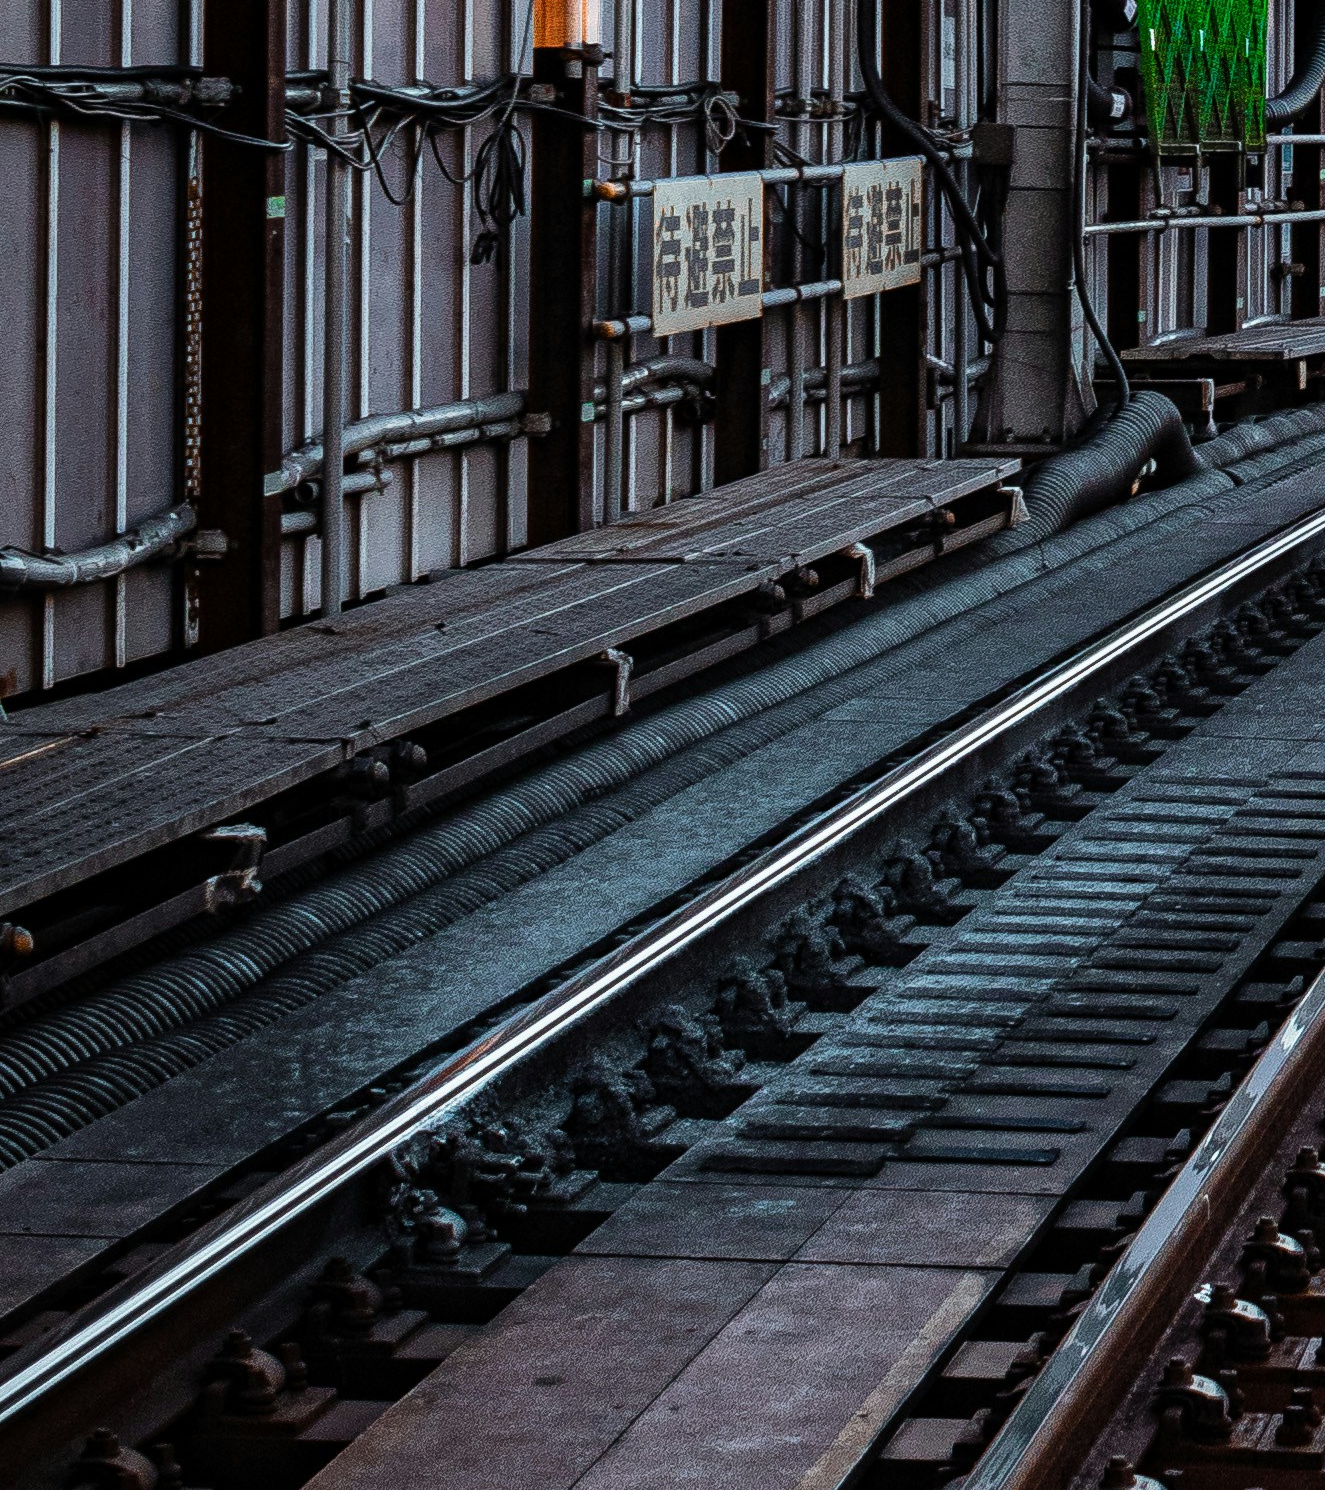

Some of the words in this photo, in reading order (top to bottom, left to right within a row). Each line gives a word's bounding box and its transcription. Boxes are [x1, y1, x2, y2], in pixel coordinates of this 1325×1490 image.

[654, 198, 760, 314] 待避禁止
[844, 178, 921, 280] 待避禁止
